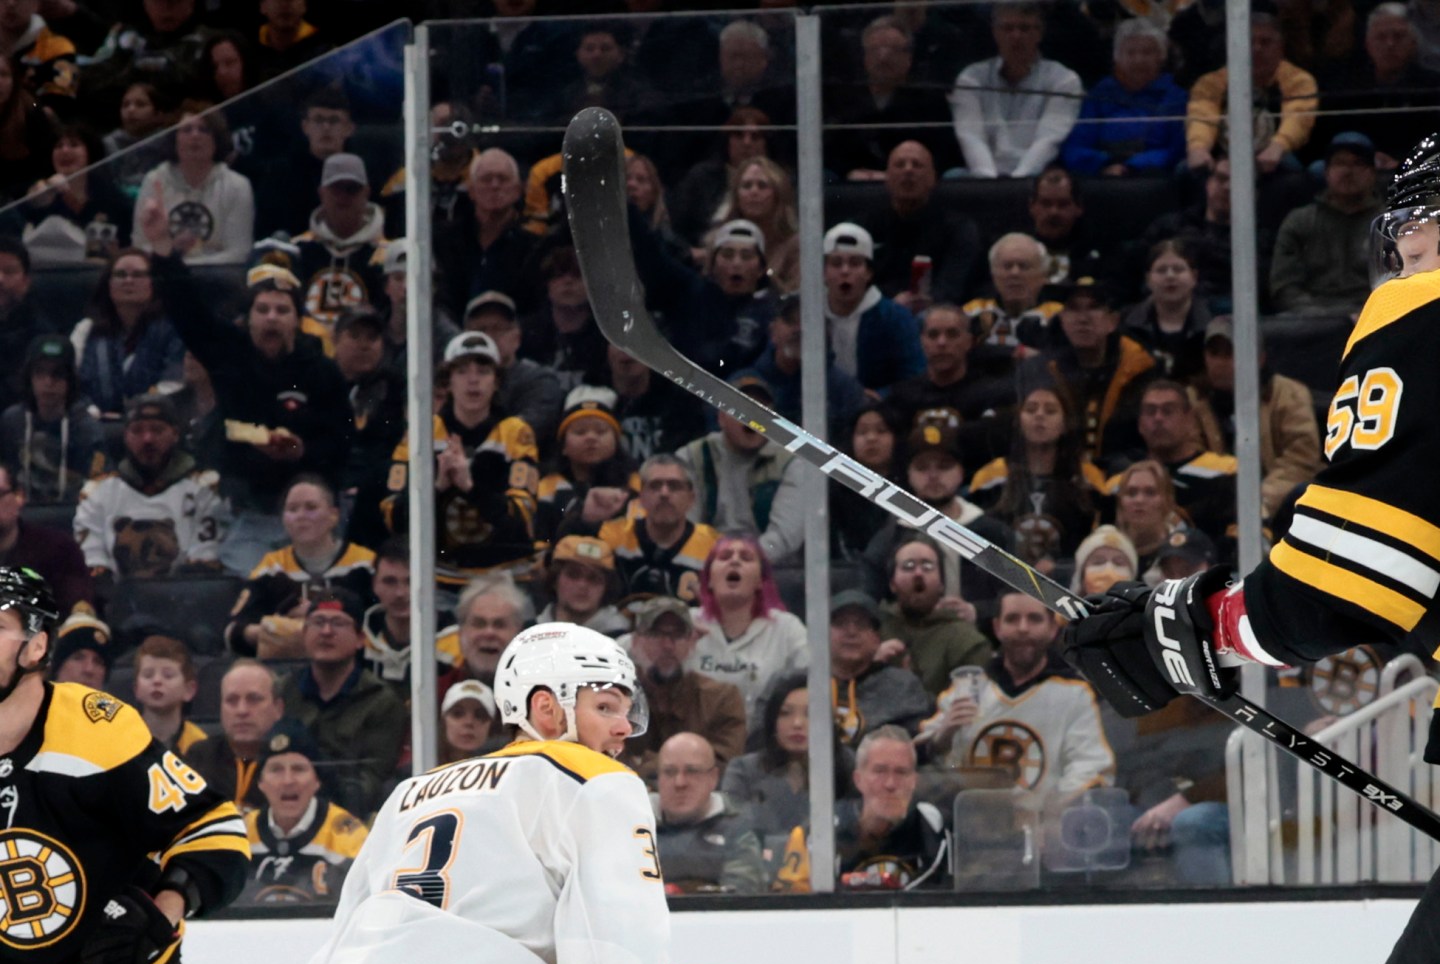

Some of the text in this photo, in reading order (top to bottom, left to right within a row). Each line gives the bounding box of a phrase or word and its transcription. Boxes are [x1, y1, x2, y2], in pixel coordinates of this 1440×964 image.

[1325, 367, 1403, 461] 59
[772, 416, 991, 561] TRUE
[147, 750, 207, 814] 46
[399, 761, 511, 812] LAUZON
[387, 807, 464, 911] 3
[633, 825, 662, 882] 3
